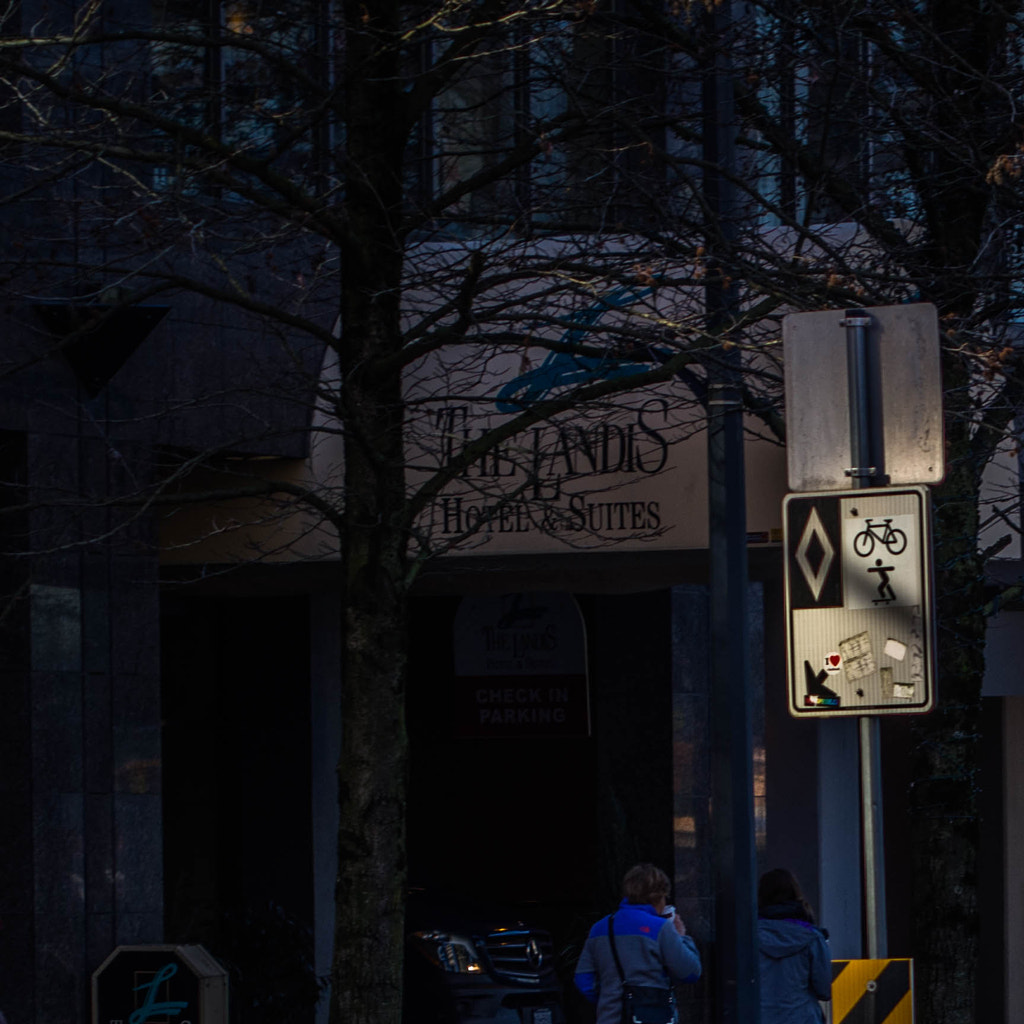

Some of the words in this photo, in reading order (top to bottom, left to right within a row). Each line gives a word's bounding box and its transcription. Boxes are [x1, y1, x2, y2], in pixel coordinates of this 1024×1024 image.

[436, 406, 516, 477] THE
[531, 399, 668, 501] LANDIS
[441, 497, 529, 534] HOTEL
[542, 511, 558, 531] &
[569, 495, 661, 532] SUITES
[475, 688, 544, 703] CHECK
[549, 688, 569, 703] IN
[479, 707, 567, 725] PARKING
